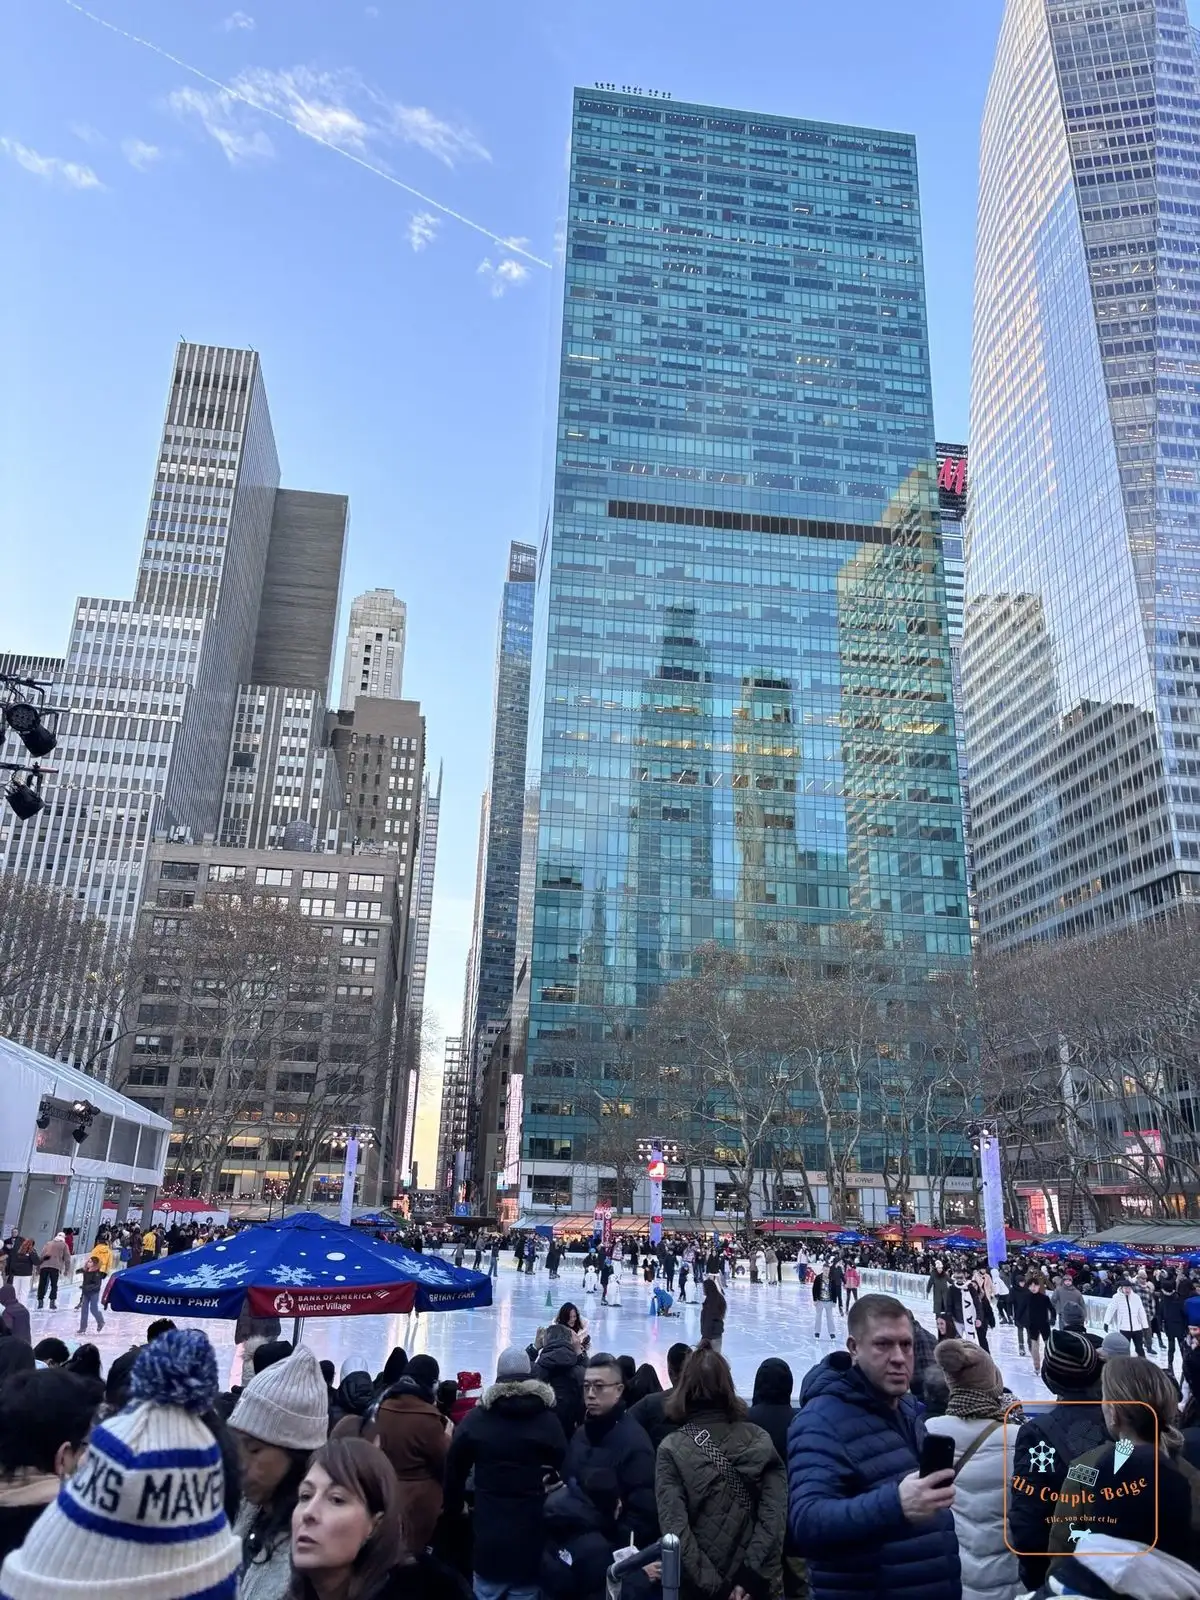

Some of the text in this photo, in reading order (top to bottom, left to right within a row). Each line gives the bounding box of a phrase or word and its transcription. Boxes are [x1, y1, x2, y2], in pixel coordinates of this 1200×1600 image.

[135, 1294, 220, 1308] BRYANT PARK
[335, 1292, 373, 1301] AMERICA
[429, 1292, 455, 1303] BRYANT
[298, 1302, 351, 1312] Winter Village
